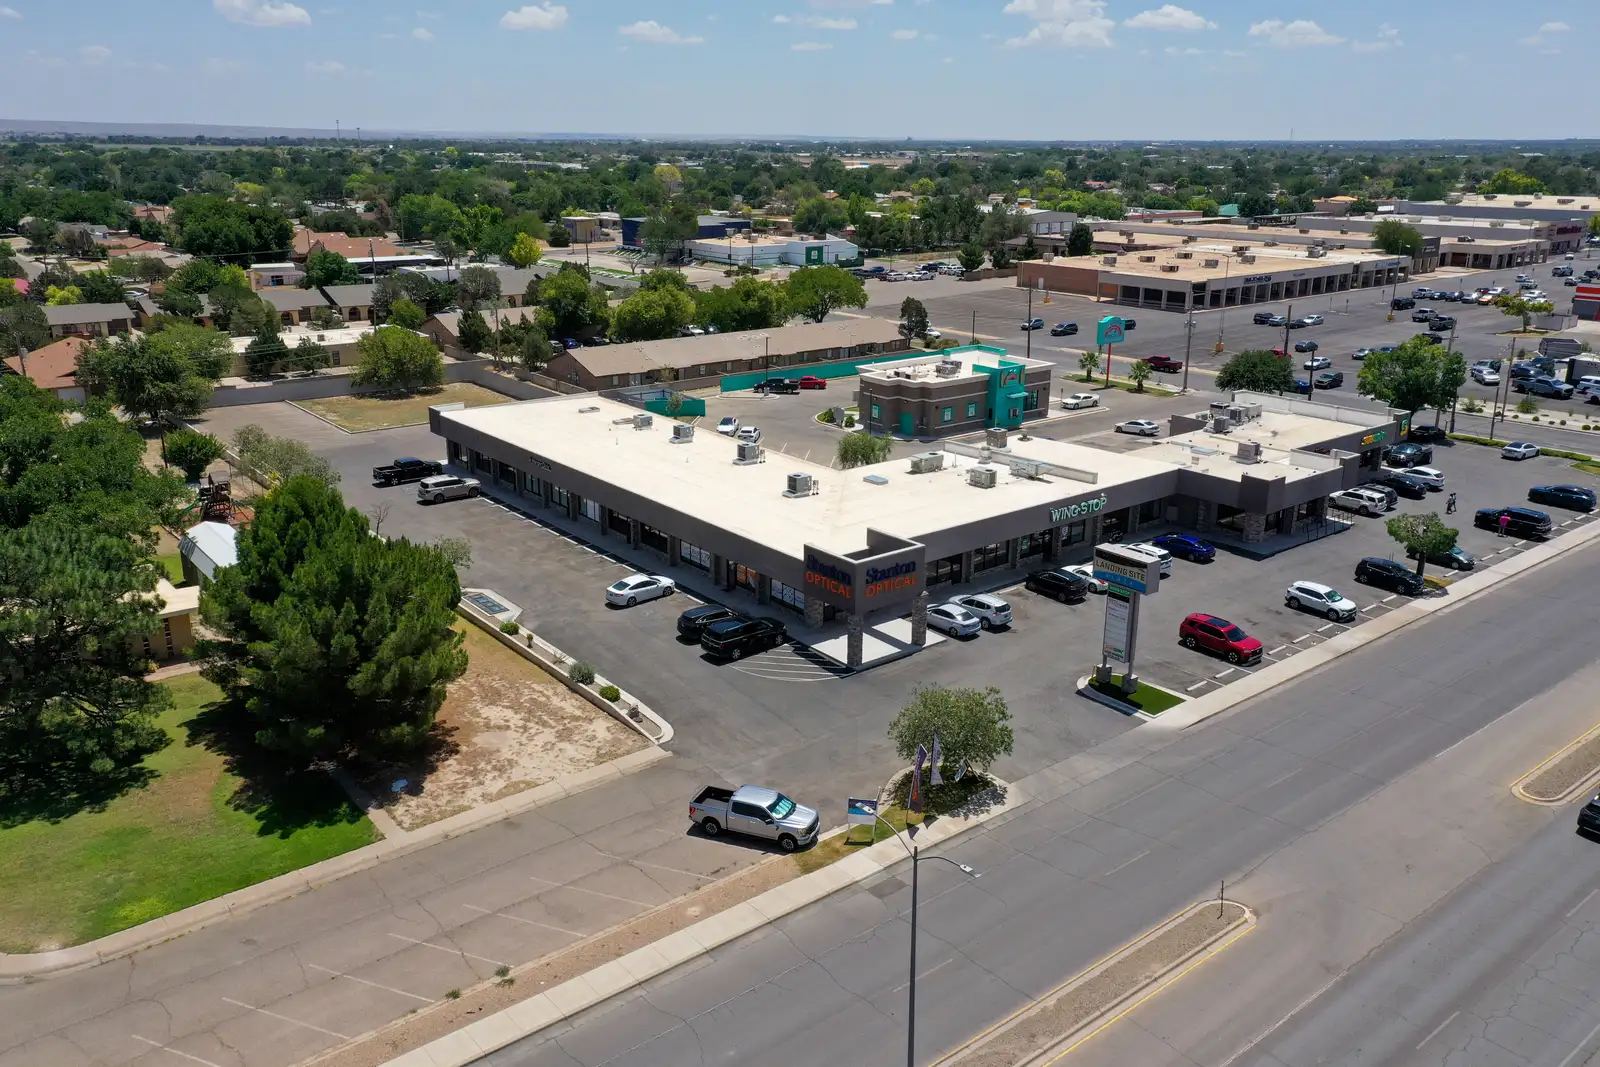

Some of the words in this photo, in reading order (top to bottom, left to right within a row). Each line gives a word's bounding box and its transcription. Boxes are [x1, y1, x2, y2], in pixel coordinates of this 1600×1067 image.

[866, 560, 916, 585] Stanton
[1096, 560, 1128, 576] LANDING
[1128, 570, 1146, 582] SITE
[805, 570, 852, 599] OPTICAL
[865, 574, 916, 598] OPTICAL
